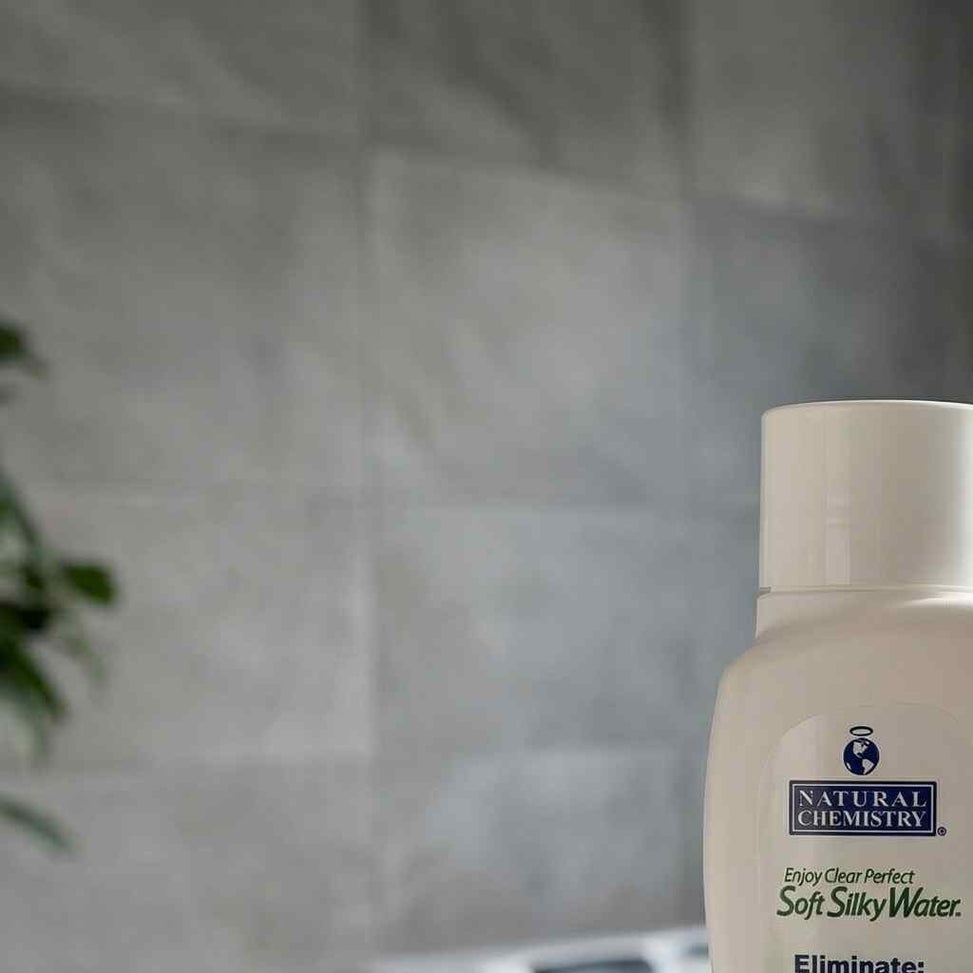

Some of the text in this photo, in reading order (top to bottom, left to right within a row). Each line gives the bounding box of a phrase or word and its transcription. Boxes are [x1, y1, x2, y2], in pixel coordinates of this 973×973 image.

[799, 789, 927, 808] NATURAL
[797, 809, 926, 828] CHEMISTRY
[784, 867, 915, 886] Enjoy Clear Perfect
[776, 886, 824, 920] Soft
[827, 886, 887, 921] Silky
